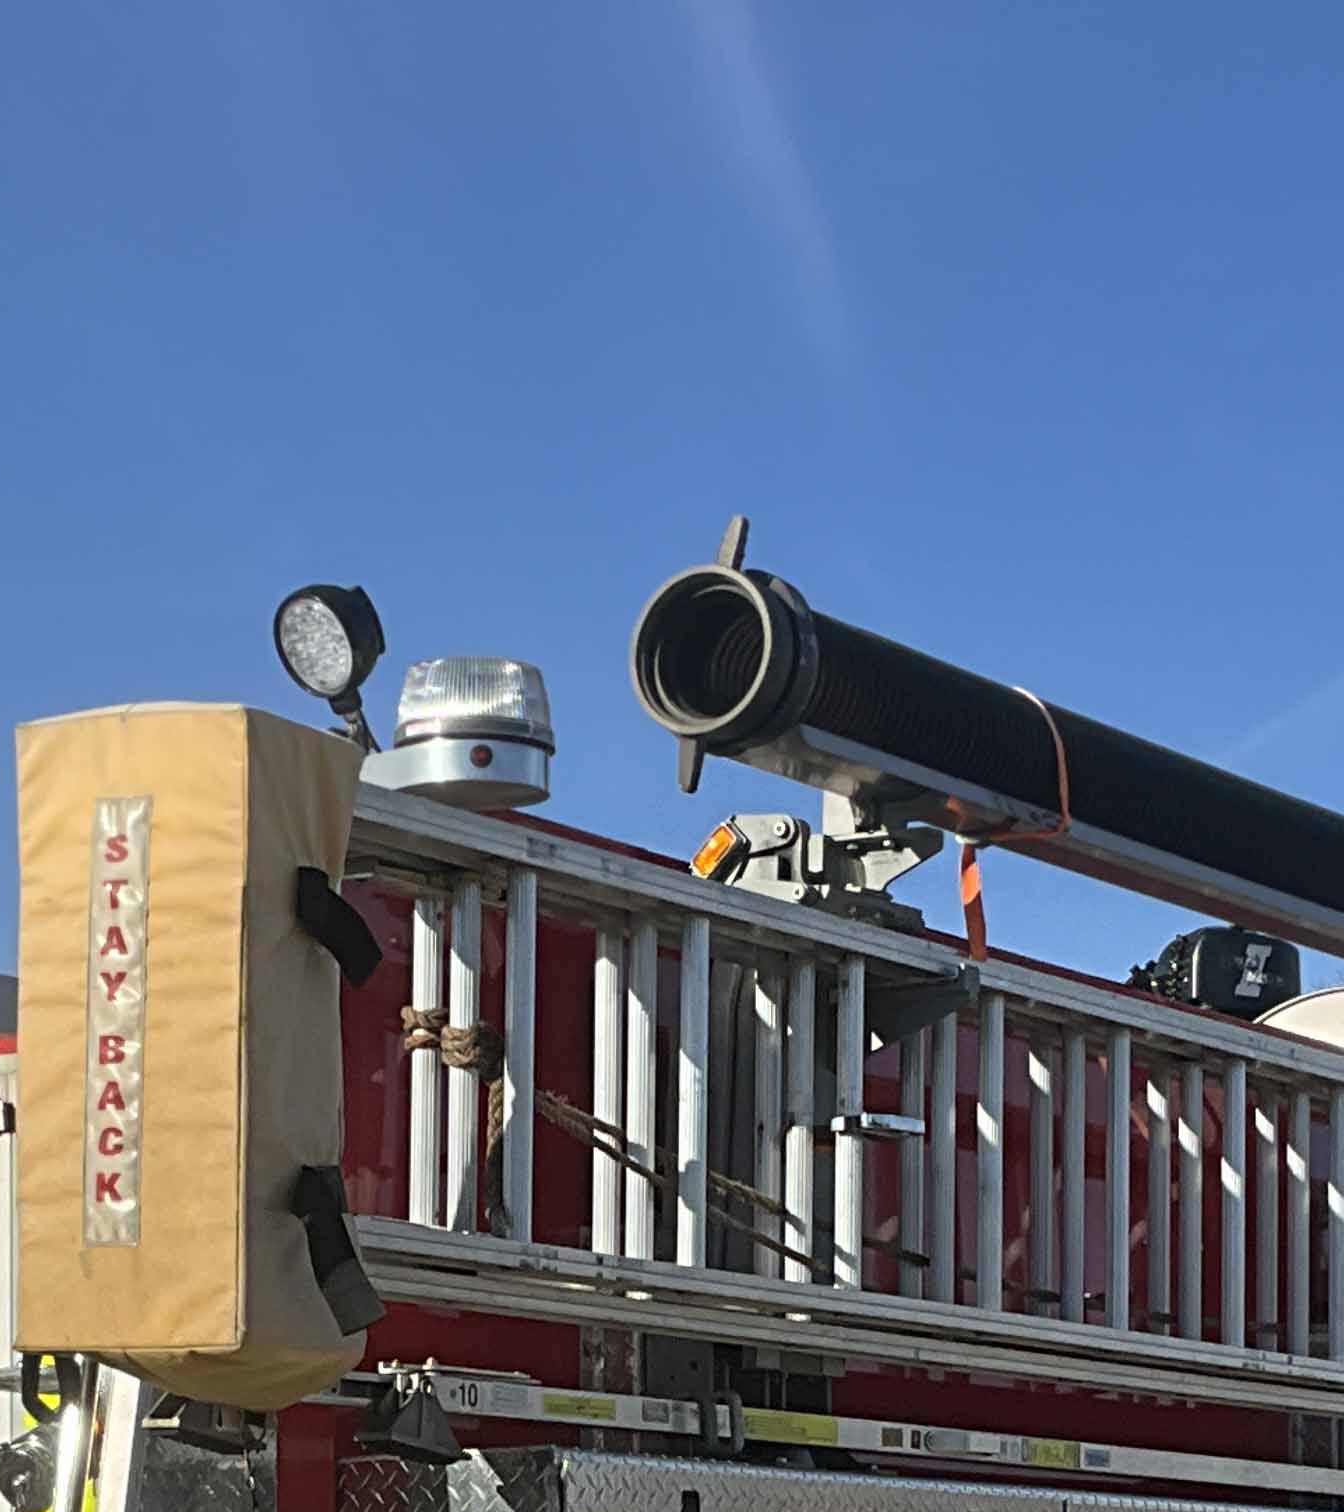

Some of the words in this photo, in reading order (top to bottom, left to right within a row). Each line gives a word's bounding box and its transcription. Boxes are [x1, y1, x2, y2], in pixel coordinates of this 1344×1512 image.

[98, 833, 130, 1003] STAY
[95, 1034, 127, 1203] BACK
[459, 1383, 478, 1407] 10
